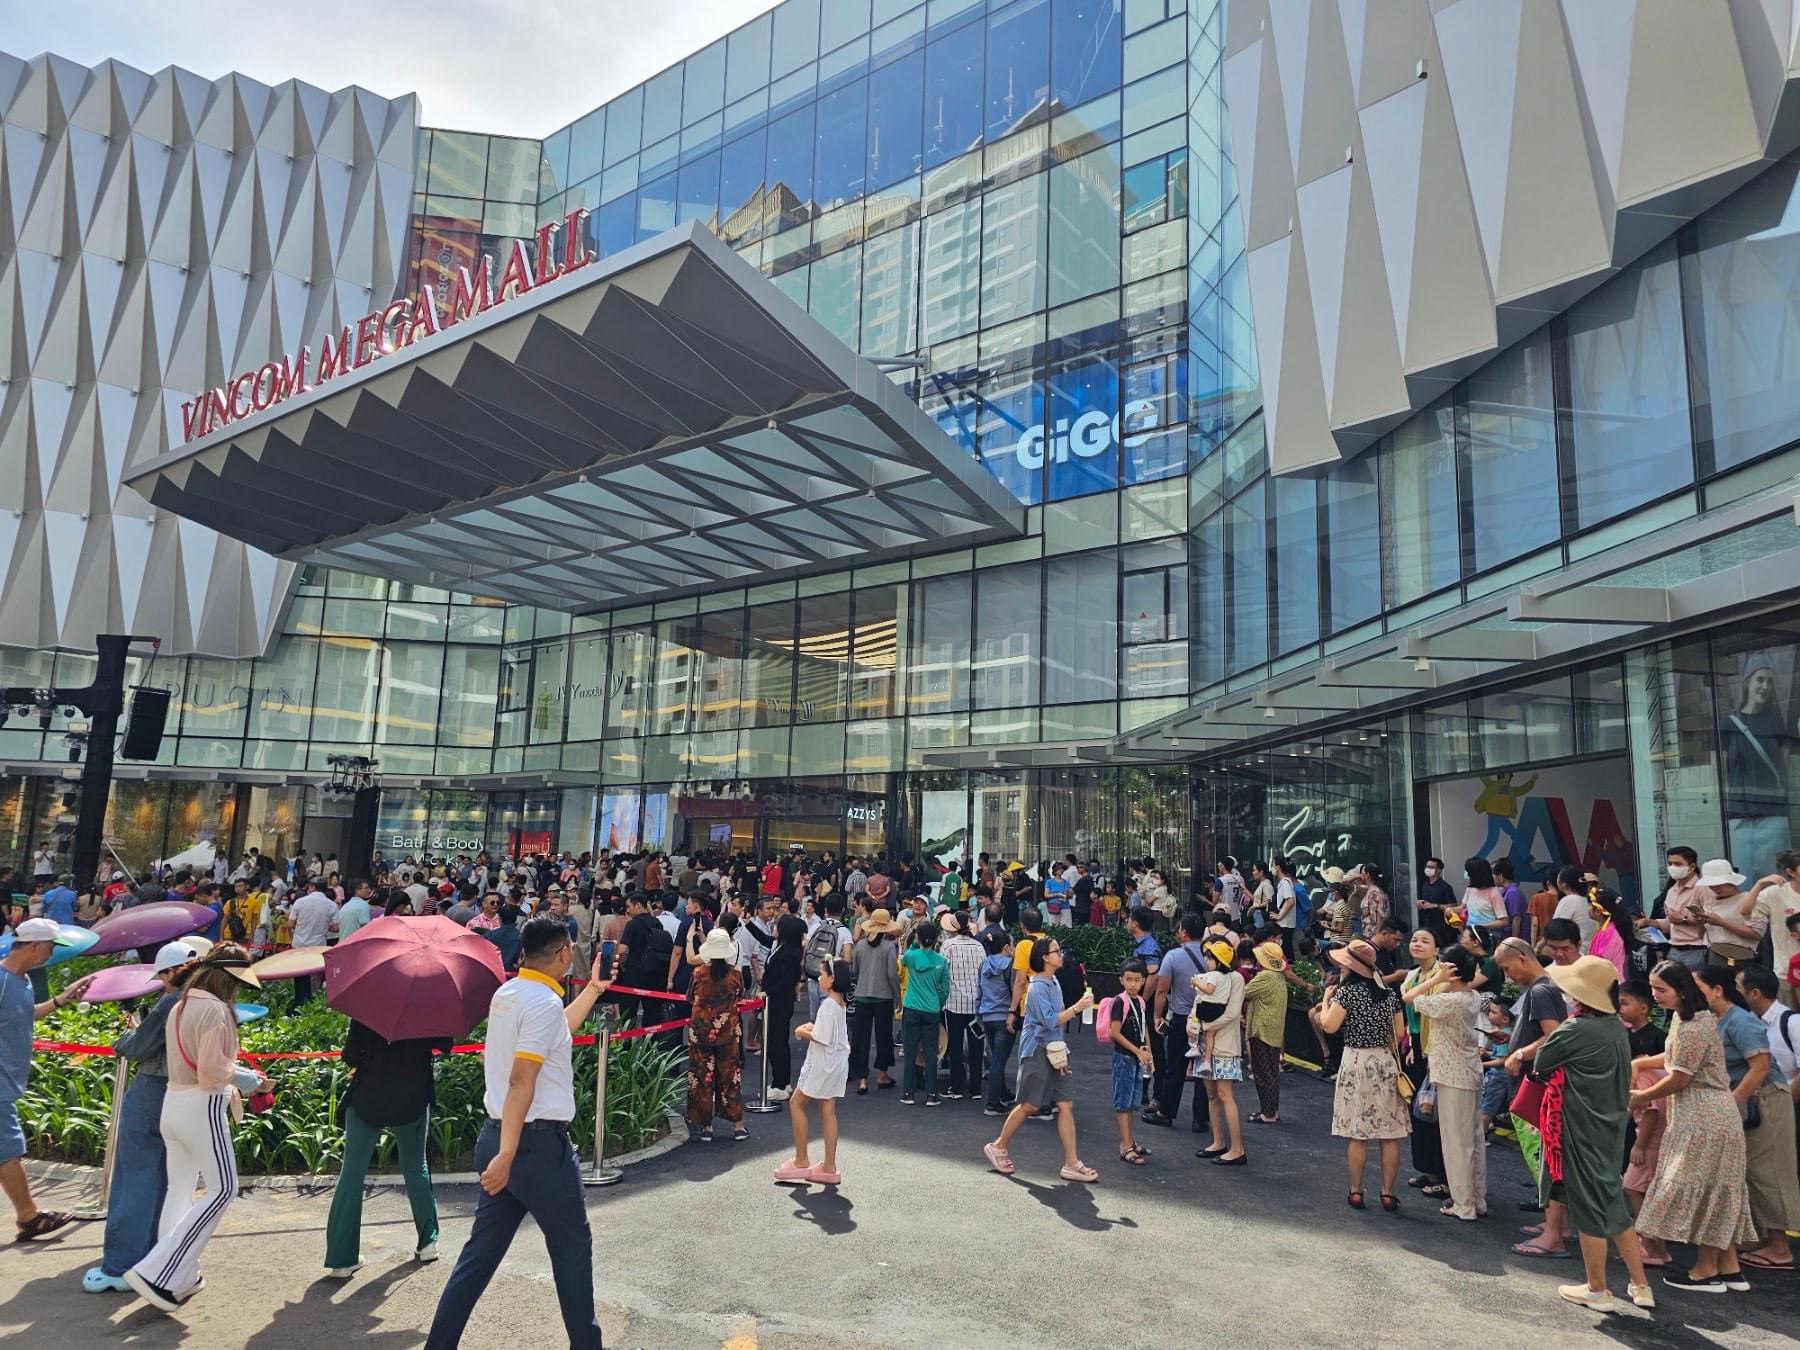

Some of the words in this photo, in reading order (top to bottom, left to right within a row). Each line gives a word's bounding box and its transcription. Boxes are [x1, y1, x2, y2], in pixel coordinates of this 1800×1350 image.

[180, 346, 312, 443] VINCOM
[315, 285, 443, 386] MEGA
[448, 207, 597, 326] MALL
[842, 807, 877, 820] AZZYS
[432, 836, 443, 849] &
[446, 837, 484, 852] Body
[414, 853, 459, 866] Woks
[950, 882, 958, 895] 9
